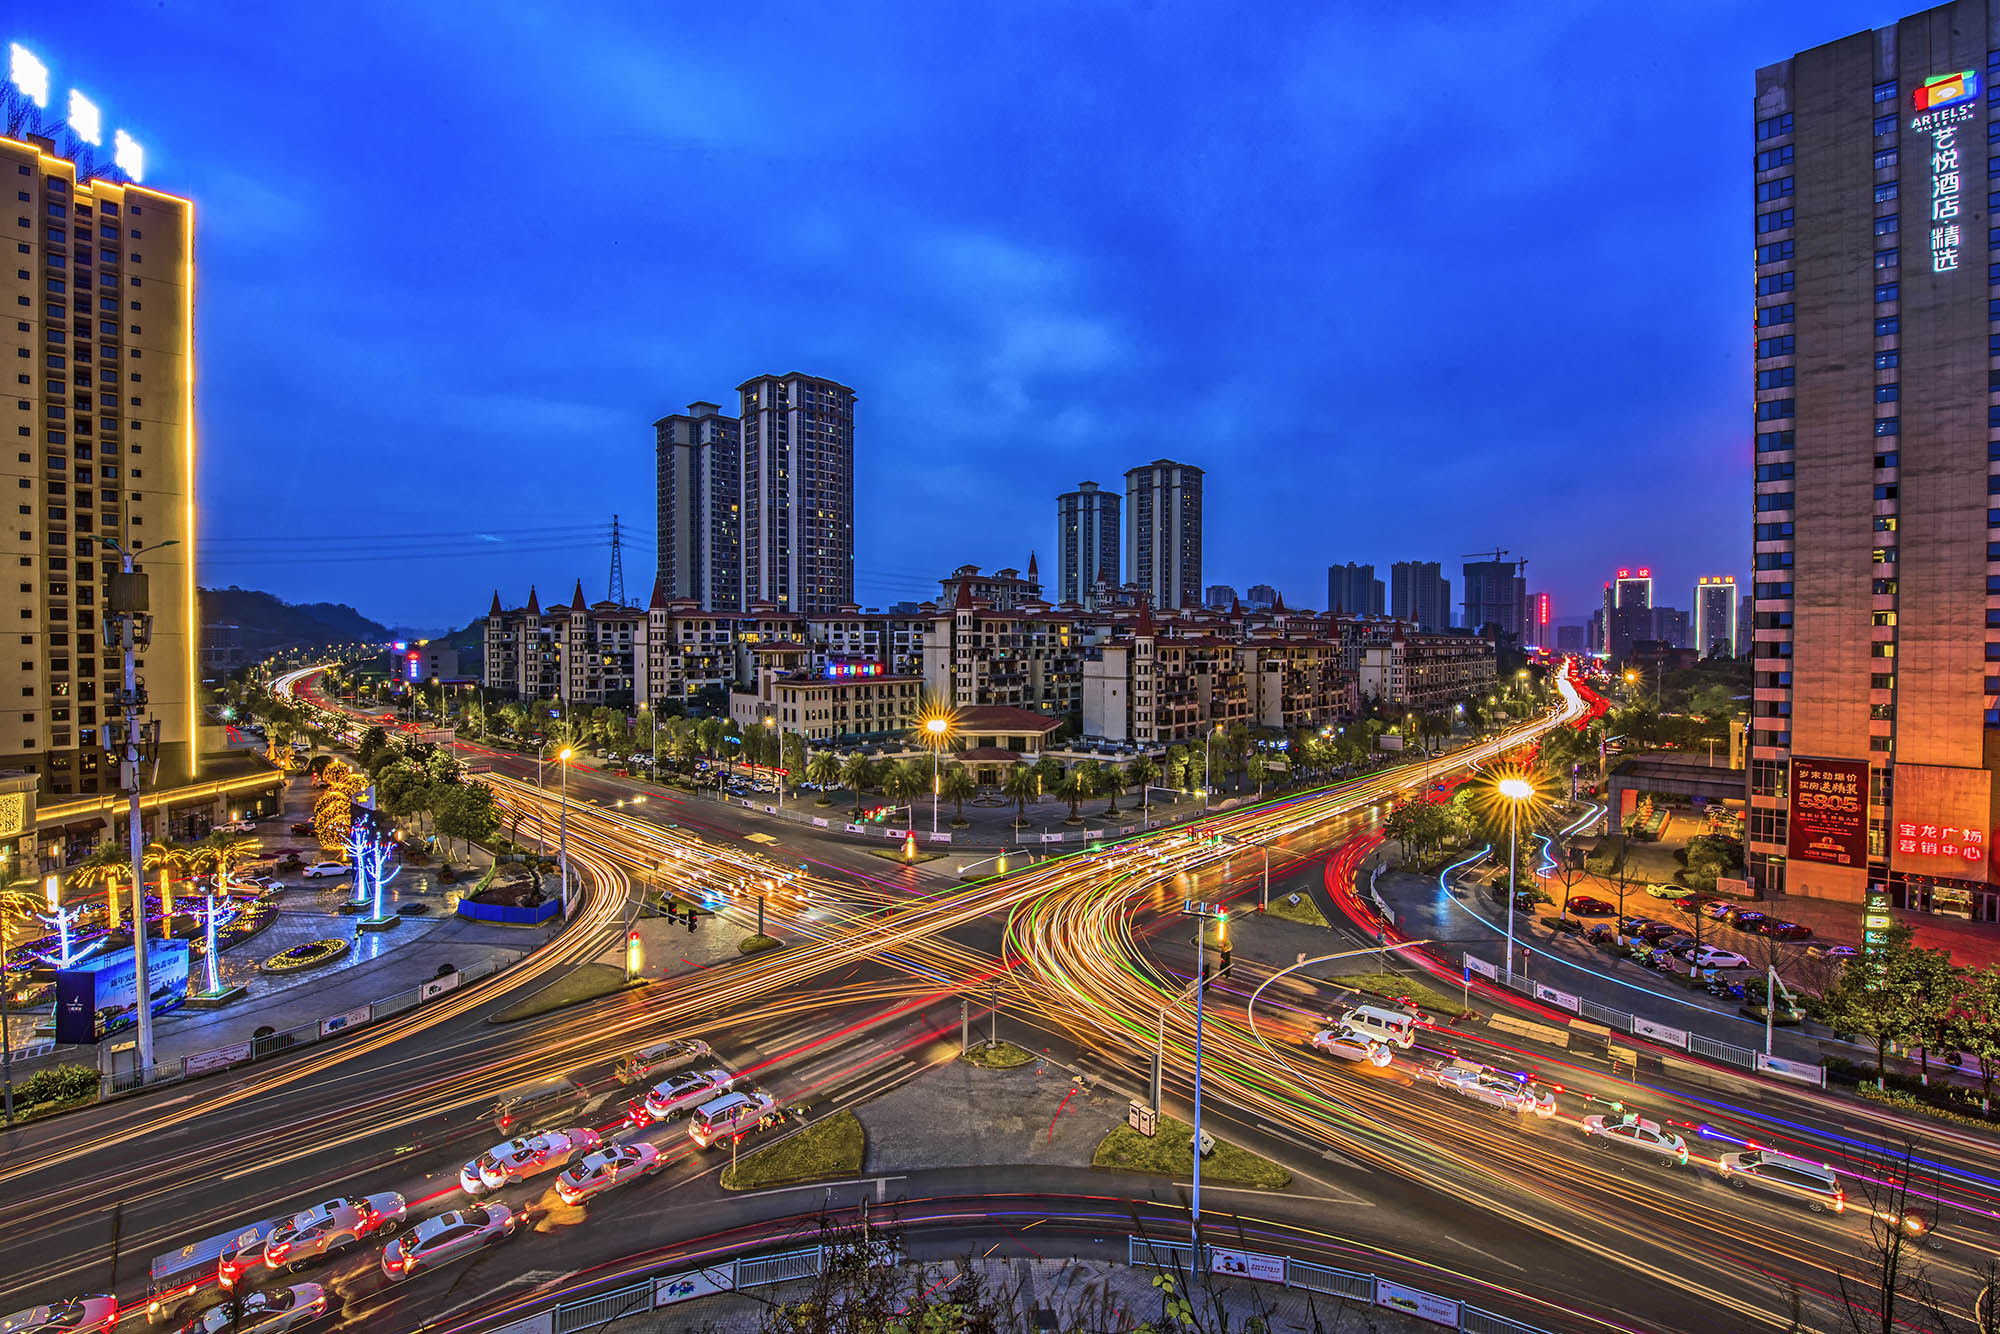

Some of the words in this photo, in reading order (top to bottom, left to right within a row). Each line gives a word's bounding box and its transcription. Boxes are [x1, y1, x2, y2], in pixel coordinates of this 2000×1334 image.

[1911, 103, 1976, 129] ARTELS+
[1798, 792, 1859, 813] 5805
[1899, 823, 1983, 844] 宝龙广场
[1899, 839, 1982, 860] 营销中心
